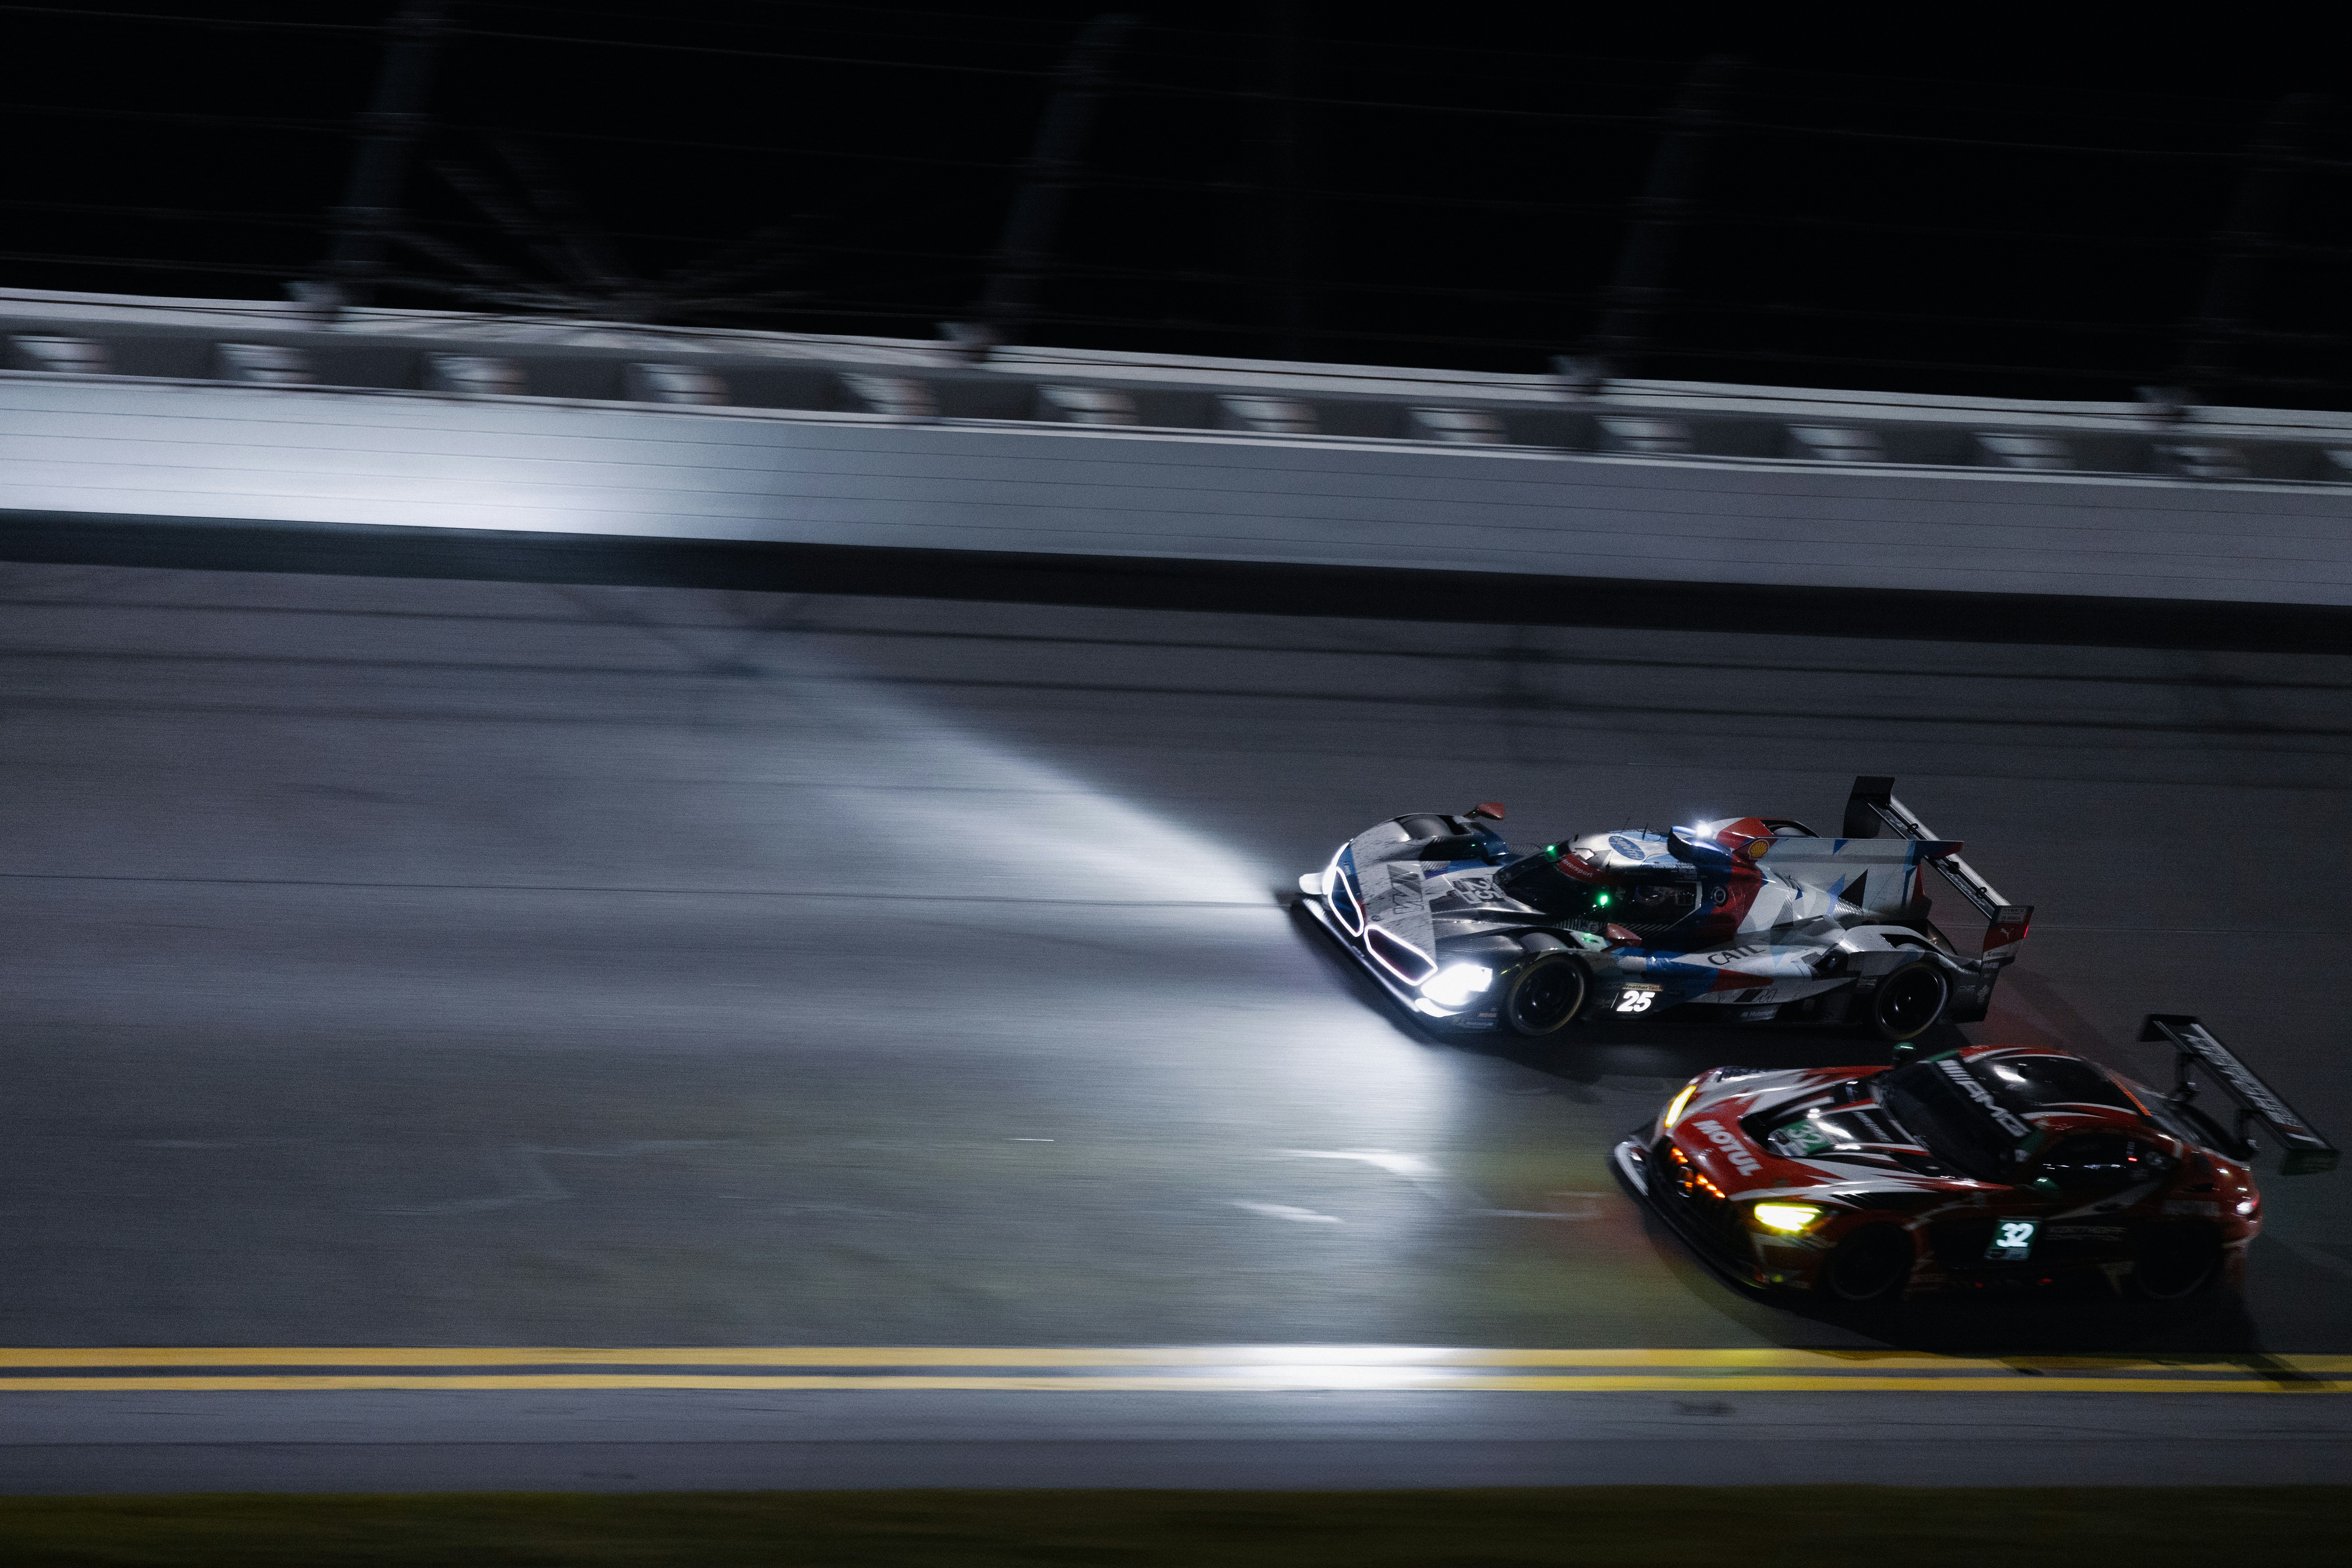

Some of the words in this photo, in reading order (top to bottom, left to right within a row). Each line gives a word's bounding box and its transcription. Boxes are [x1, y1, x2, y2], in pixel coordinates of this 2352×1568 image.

[1462, 880, 1503, 900] 25
[1708, 946, 1766, 965] CATL
[1617, 990, 1655, 1012] 25
[1955, 1081, 2031, 1137] AMG
[1691, 1120, 1763, 1176] MOTUL
[1787, 1124, 1828, 1149] 32
[1996, 1223, 2034, 1247] 32
